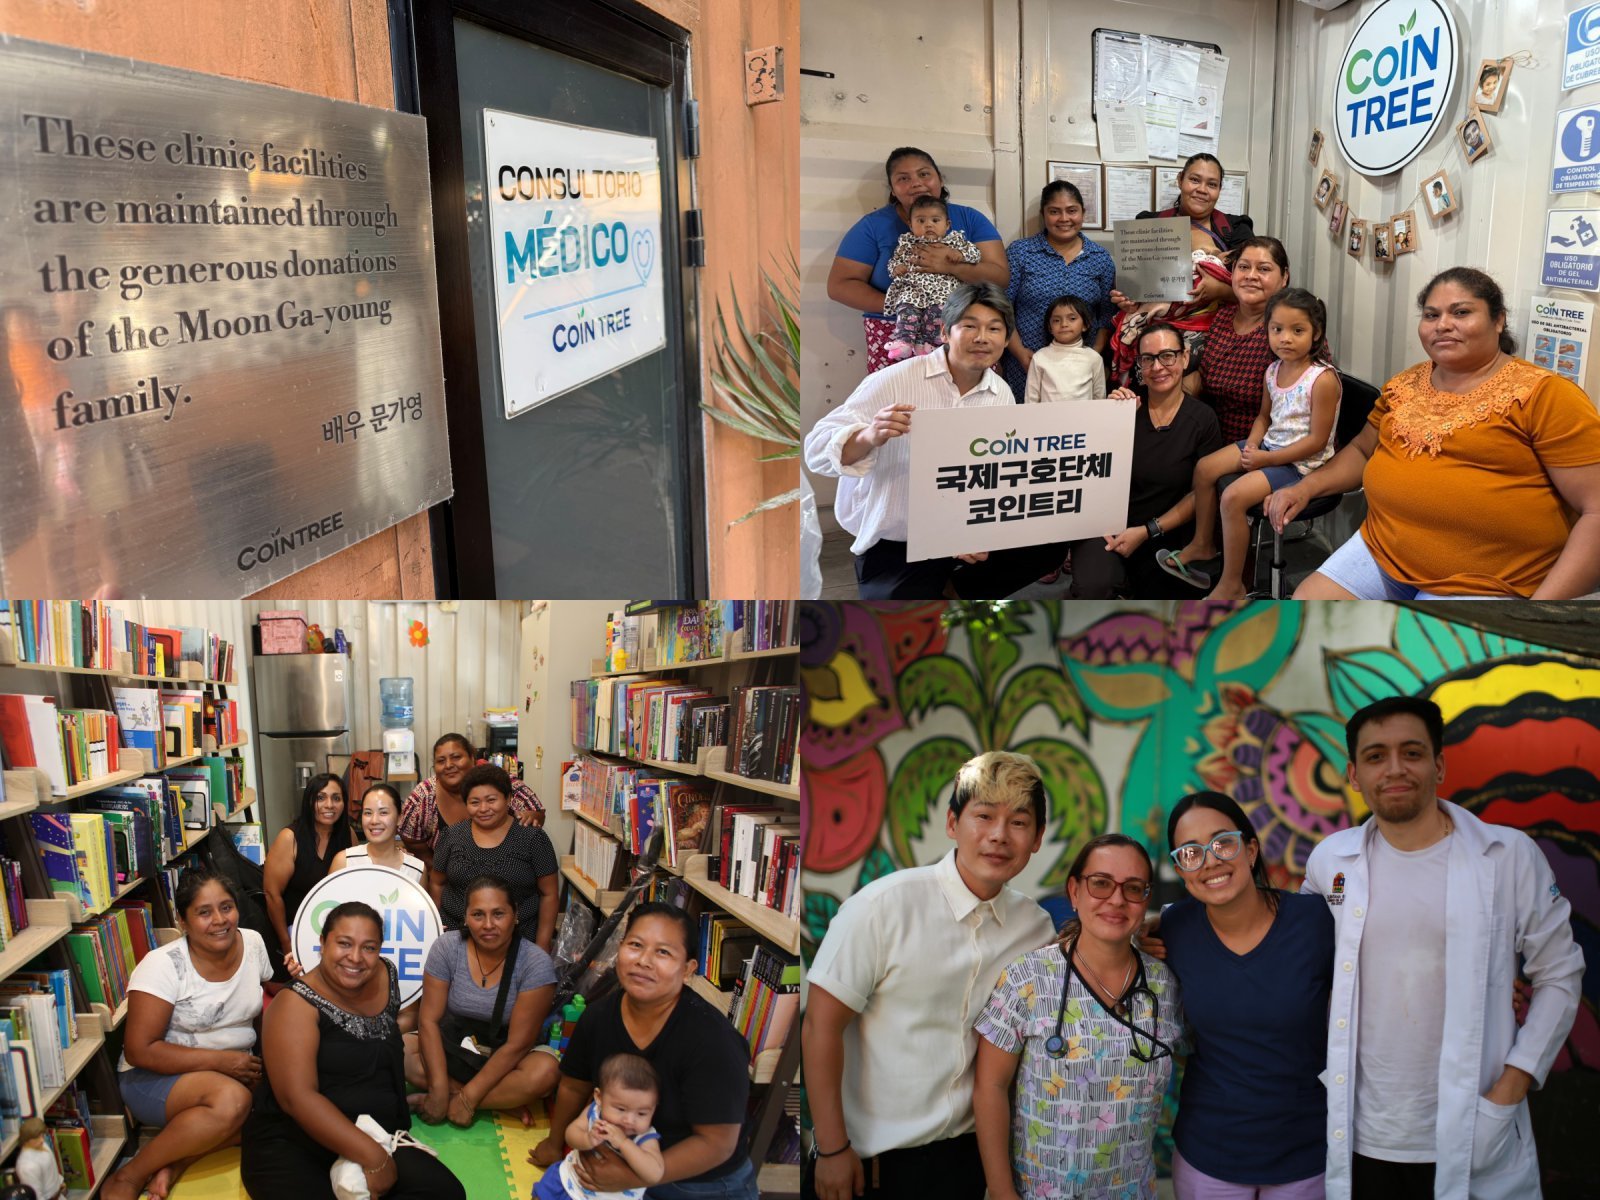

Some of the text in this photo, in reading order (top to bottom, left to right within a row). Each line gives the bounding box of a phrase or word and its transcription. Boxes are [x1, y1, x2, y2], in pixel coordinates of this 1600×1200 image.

[1346, 26, 1440, 95] COIN
[1346, 79, 1435, 138] TREE
[23, 114, 368, 182] These clinic facilities
[1566, 165, 1596, 174] CONTROL
[498, 165, 642, 202] CONSULTORIO
[33, 193, 399, 236] are maintained through
[504, 210, 629, 284] MÉDICO
[1550, 261, 1593, 271] OBLIGATORIO
[38, 249, 397, 300] the generous donations
[1546, 276, 1593, 286] ANTIBACTERIAL
[47, 299, 392, 361] of the Moon Ga-young
[552, 307, 632, 353] COIN TREE
[1536, 304, 1559, 317] COIN
[1560, 309, 1585, 320] TREE
[53, 376, 192, 432] family.
[322, 392, 424, 445] 배우 문가영
[969, 433, 1086, 457] COIN TREE
[936, 452, 1112, 492] 국제구호단체
[966, 488, 1083, 526] 코인트리
[310, 900, 426, 942] CIN
